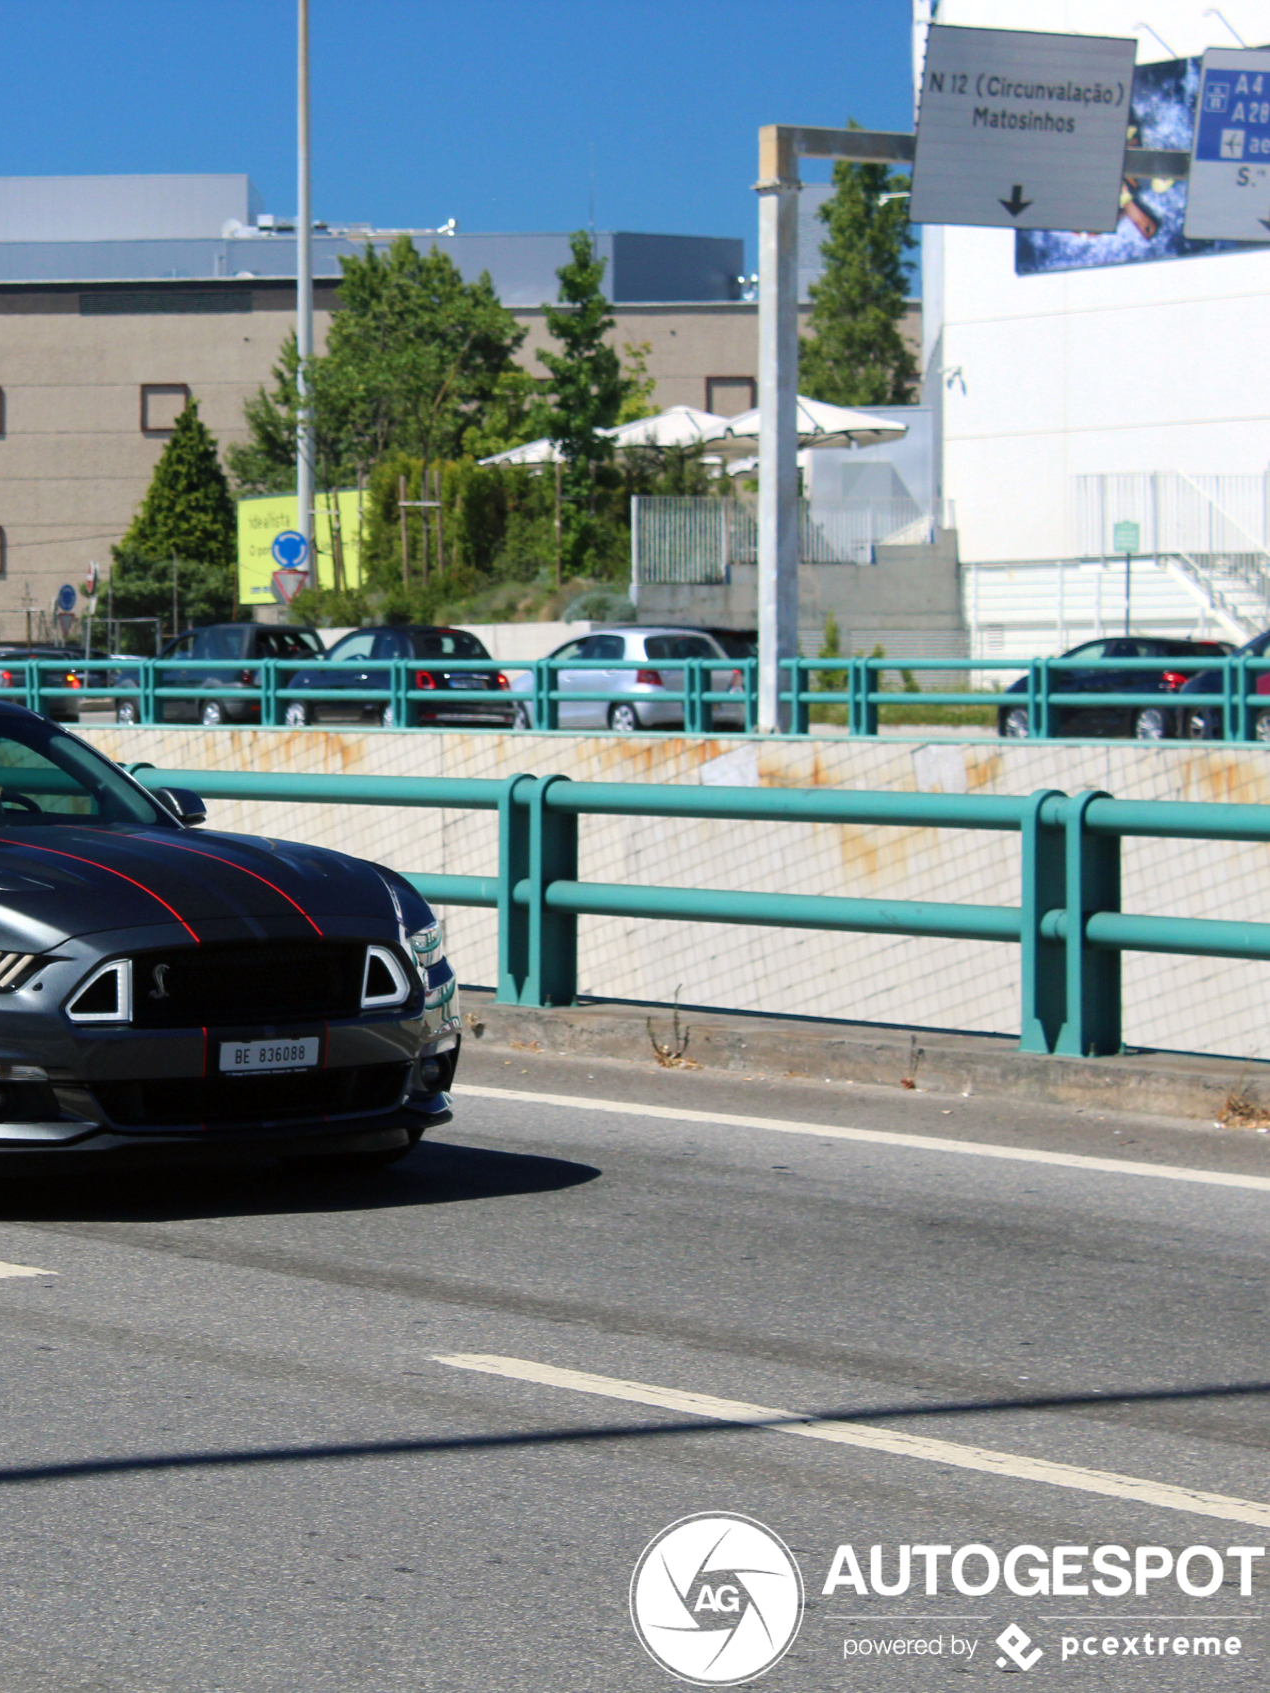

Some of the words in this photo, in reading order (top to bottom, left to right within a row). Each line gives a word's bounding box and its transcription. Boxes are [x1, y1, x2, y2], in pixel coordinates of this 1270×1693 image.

[928, 72, 947, 95] N
[950, 74, 967, 95] 12
[976, 72, 1127, 107] (Circunvalação)
[1235, 73, 1249, 95] A
[1252, 74, 1264, 96] 4
[972, 106, 1076, 134] Matosinhos
[1231, 101, 1246, 123] A
[234, 1048, 251, 1064] BE
[259, 1045, 305, 1063] 836088
